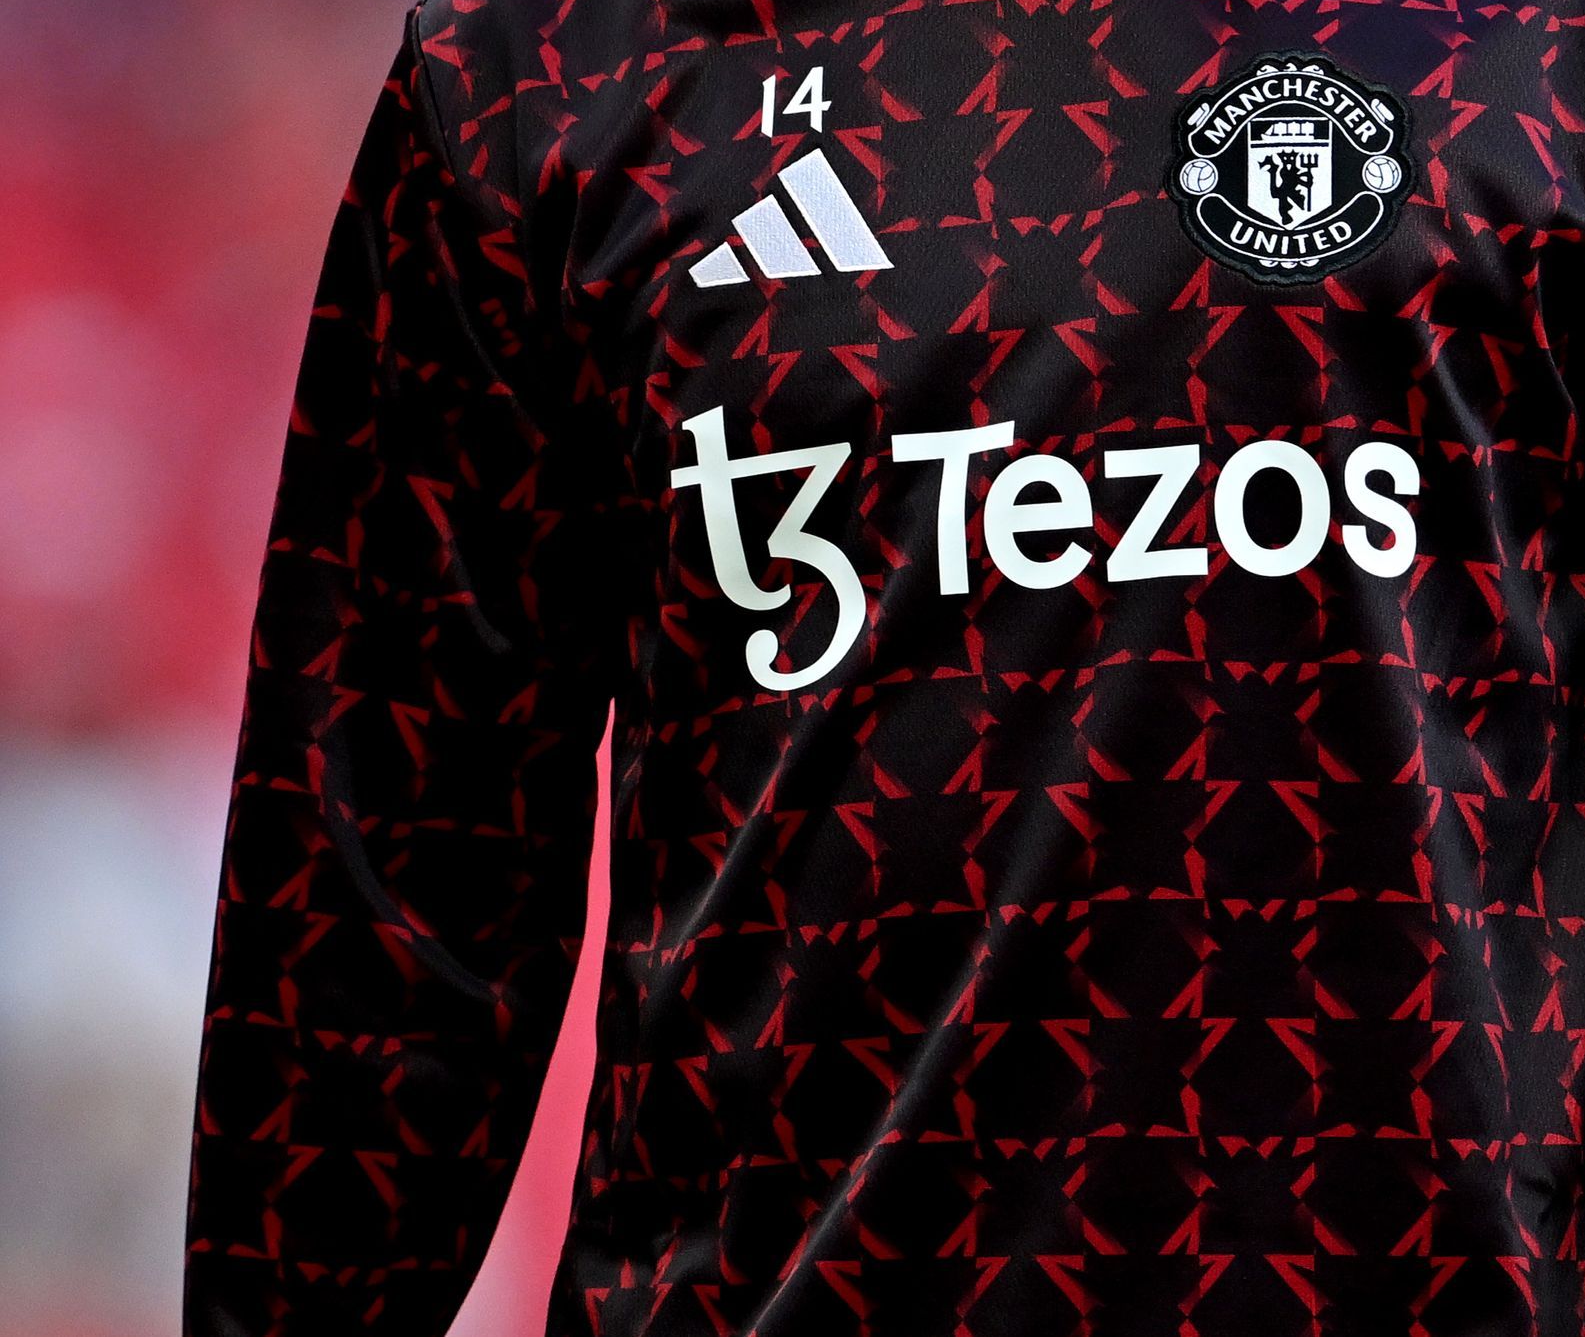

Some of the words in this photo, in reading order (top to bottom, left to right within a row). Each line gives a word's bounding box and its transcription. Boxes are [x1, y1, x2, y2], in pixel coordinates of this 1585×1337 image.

[758, 66, 833, 139] 14
[1203, 77, 1378, 145] MANCHESTER
[1229, 220, 1353, 255] UNITED
[890, 419, 1422, 597] Tezos
